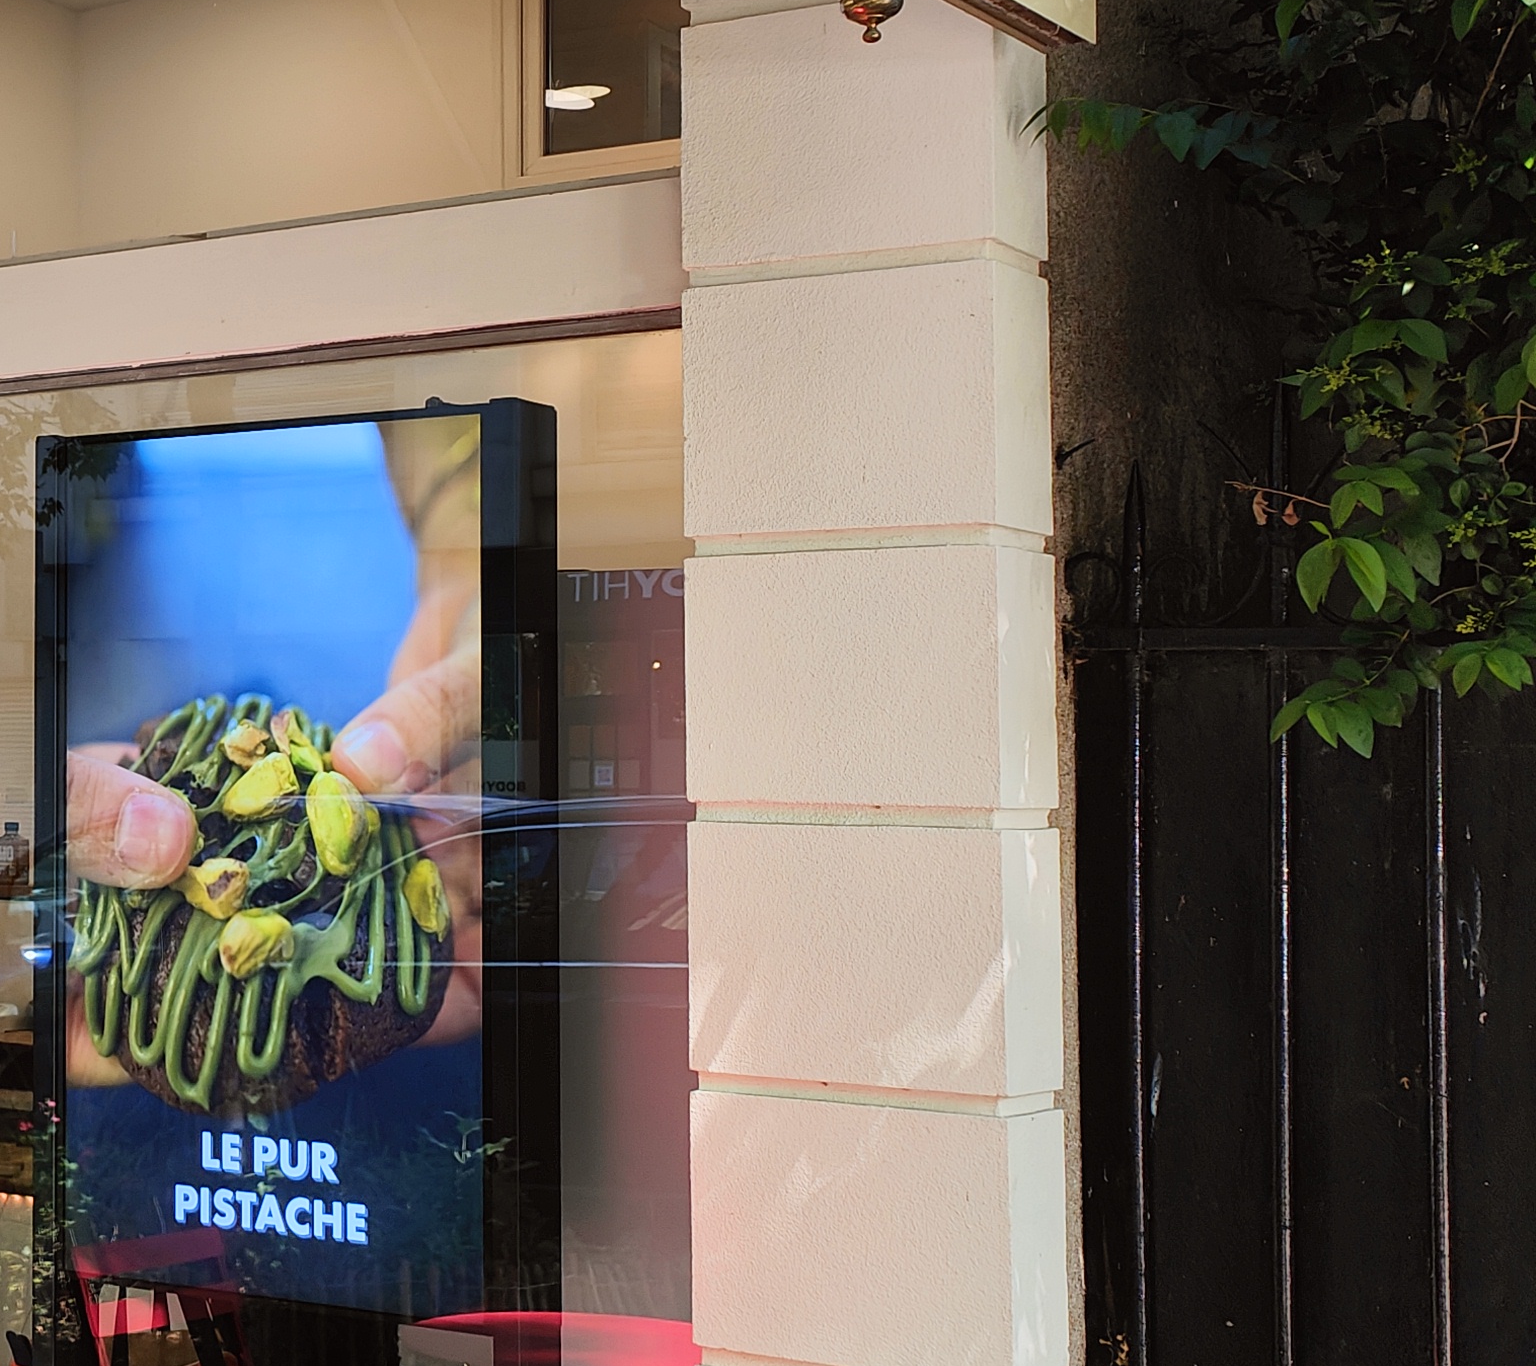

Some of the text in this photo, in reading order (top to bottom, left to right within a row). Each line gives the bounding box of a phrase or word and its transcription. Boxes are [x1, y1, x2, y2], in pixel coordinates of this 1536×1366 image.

[201, 1130, 340, 1185] LE PUR
[174, 1183, 370, 1246] PISTACHE
